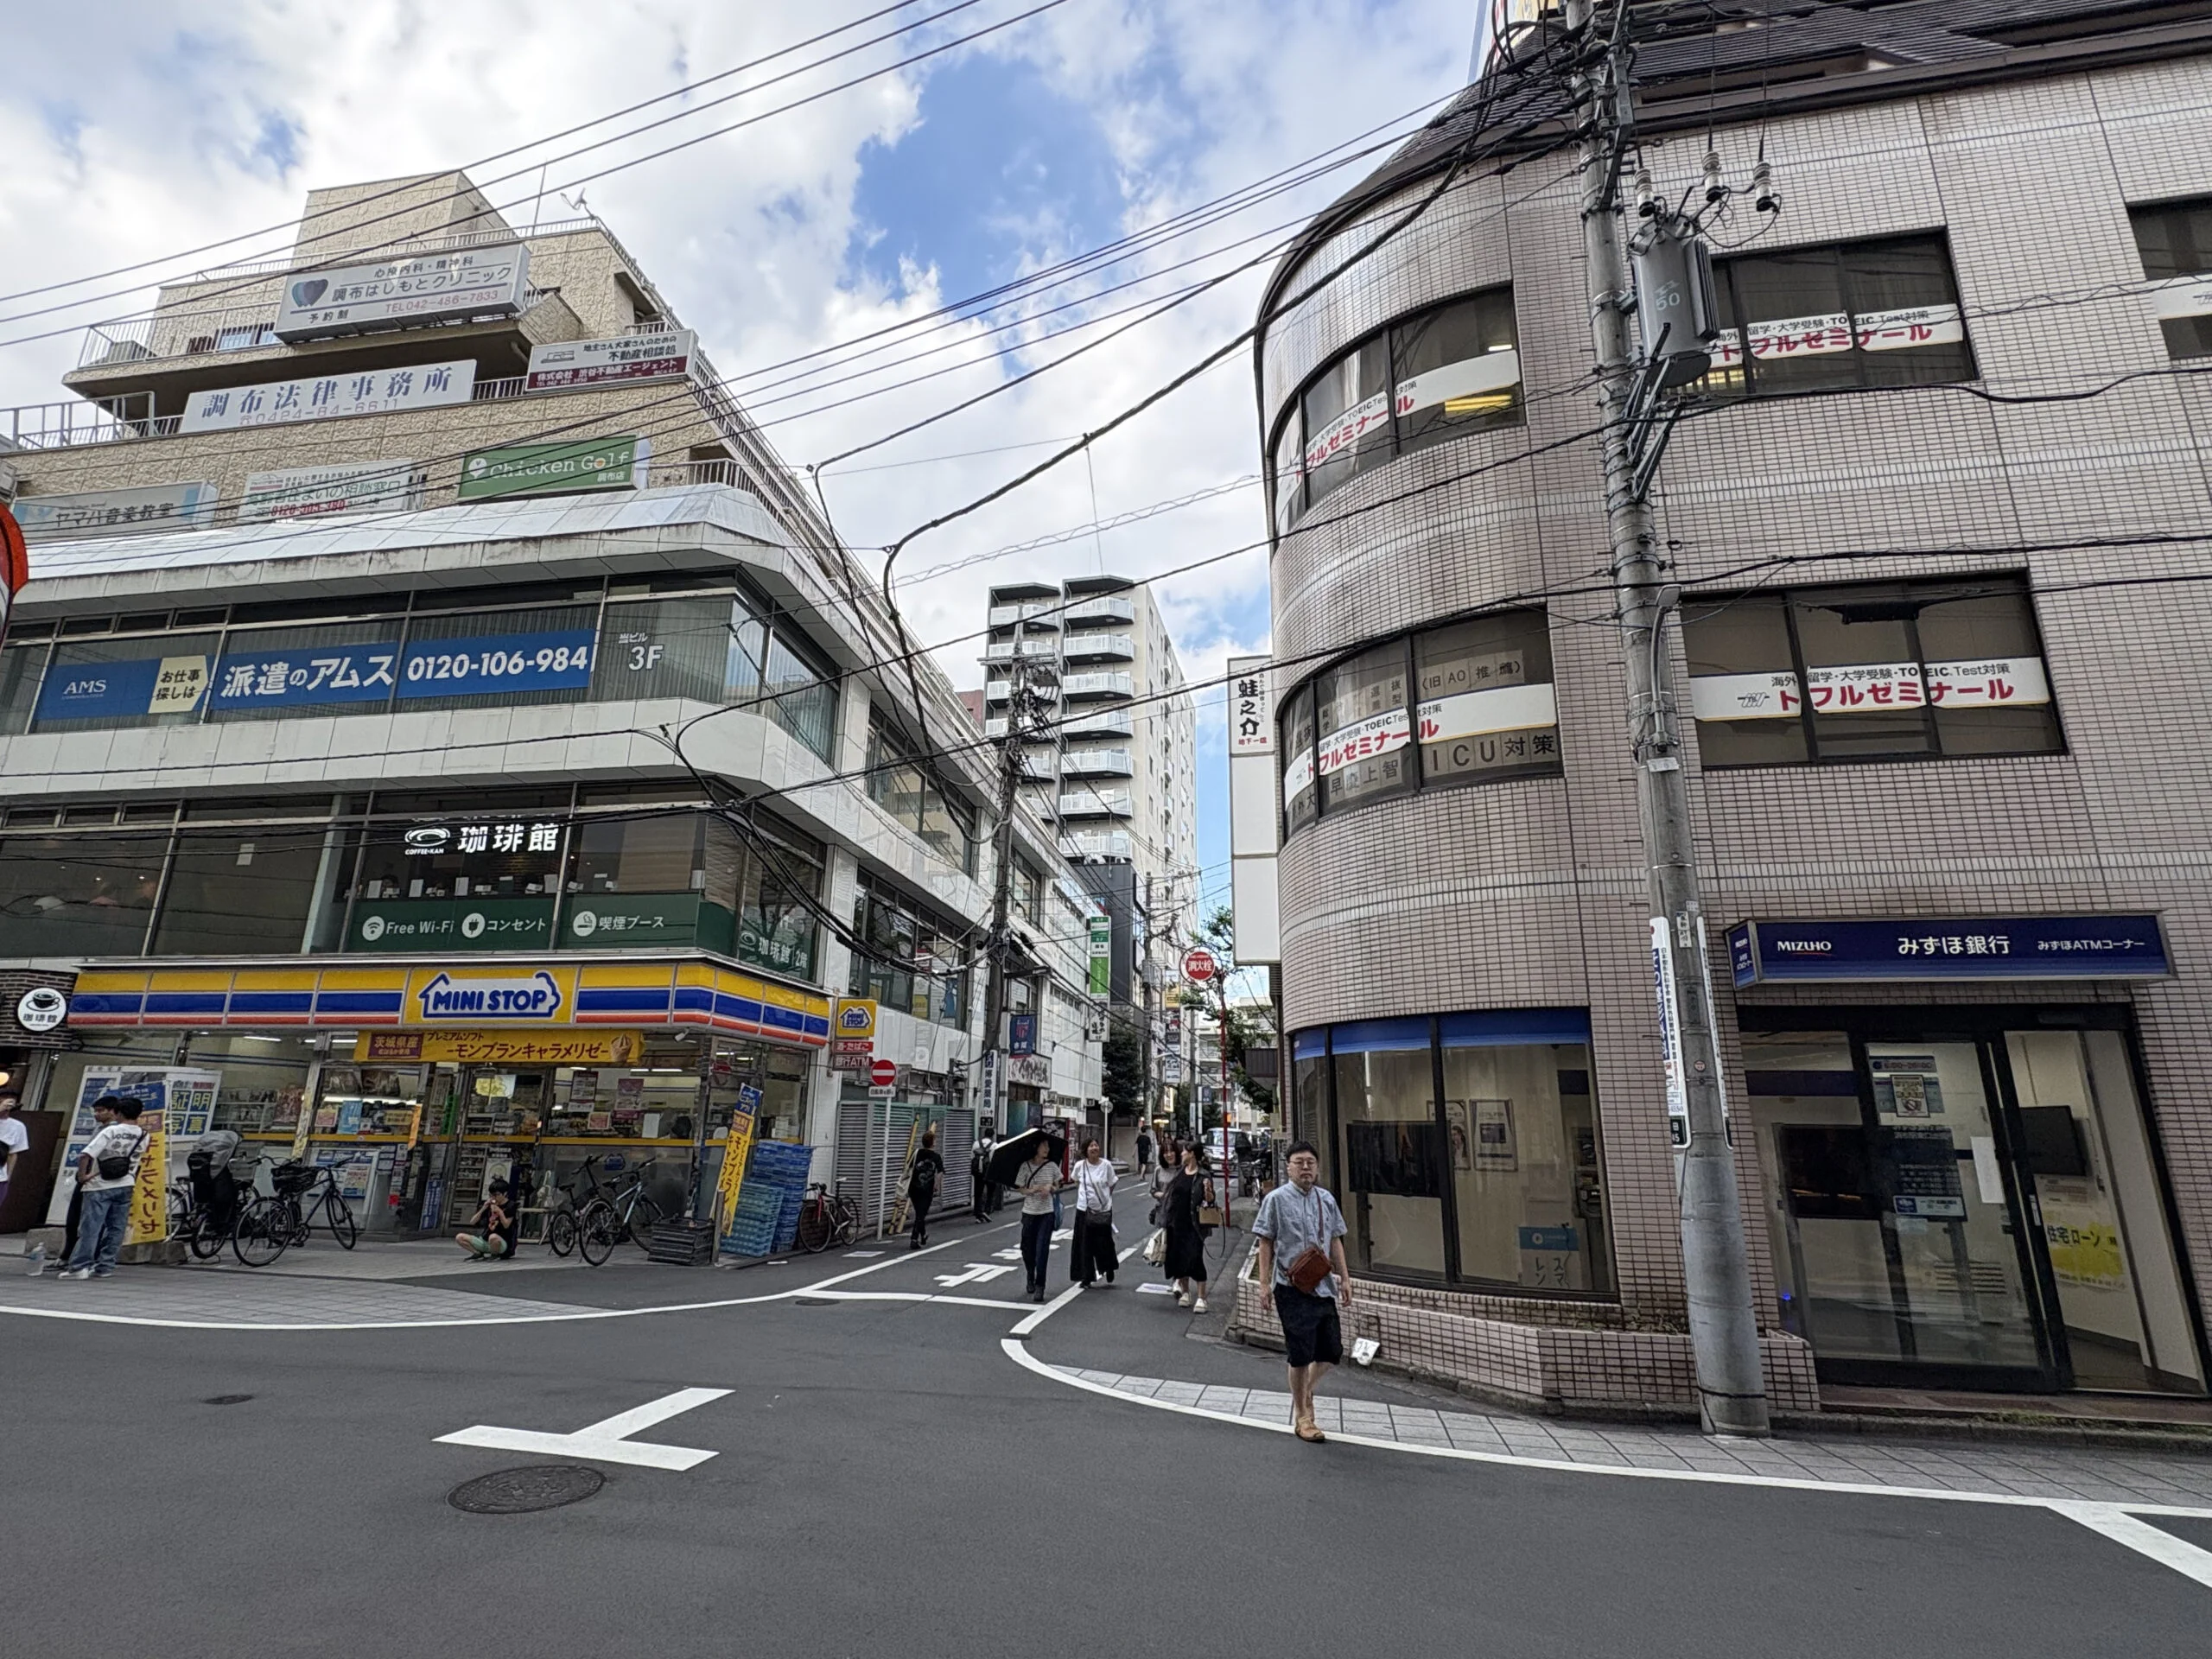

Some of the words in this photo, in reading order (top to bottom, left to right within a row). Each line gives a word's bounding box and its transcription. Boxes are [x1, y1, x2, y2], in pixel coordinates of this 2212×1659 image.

[332, 266, 512, 302] 調布はしもとクリニック
[1656, 292, 1681, 311] 50
[308, 308, 349, 324] 予約制
[1723, 323, 1933, 362] トフルゼミナール
[201, 366, 454, 418] 調布法律事務所
[490, 458, 575, 479] Chicken
[581, 451, 630, 470] Golf
[407, 645, 588, 682] 0120-106-984
[628, 645, 664, 671] 3F
[160, 668, 202, 684] お仕事
[220, 654, 395, 698] 派遣のアムス
[62, 679, 107, 695] AMS
[156, 685, 196, 701] 探しは
[1779, 678, 2014, 711] トフルゼミナール
[1308, 719, 1440, 779] トフルゼミナール
[457, 823, 560, 854] 珈琲館
[385, 922, 416, 936] Free
[419, 919, 454, 934] Wi-Fi
[486, 917, 546, 932] コンセント
[598, 914, 664, 931] 喫煙ブース
[1777, 940, 1832, 951] MIZUHO
[1897, 935, 2010, 955] みずほ銀行
[2037, 938, 2145, 950] みずほATMコーナー
[1188, 960, 1211, 971] 消火栓
[433, 990, 484, 1011] MINI
[487, 990, 547, 1011] STOP
[428, 1032, 484, 1042] プレミアムソフト
